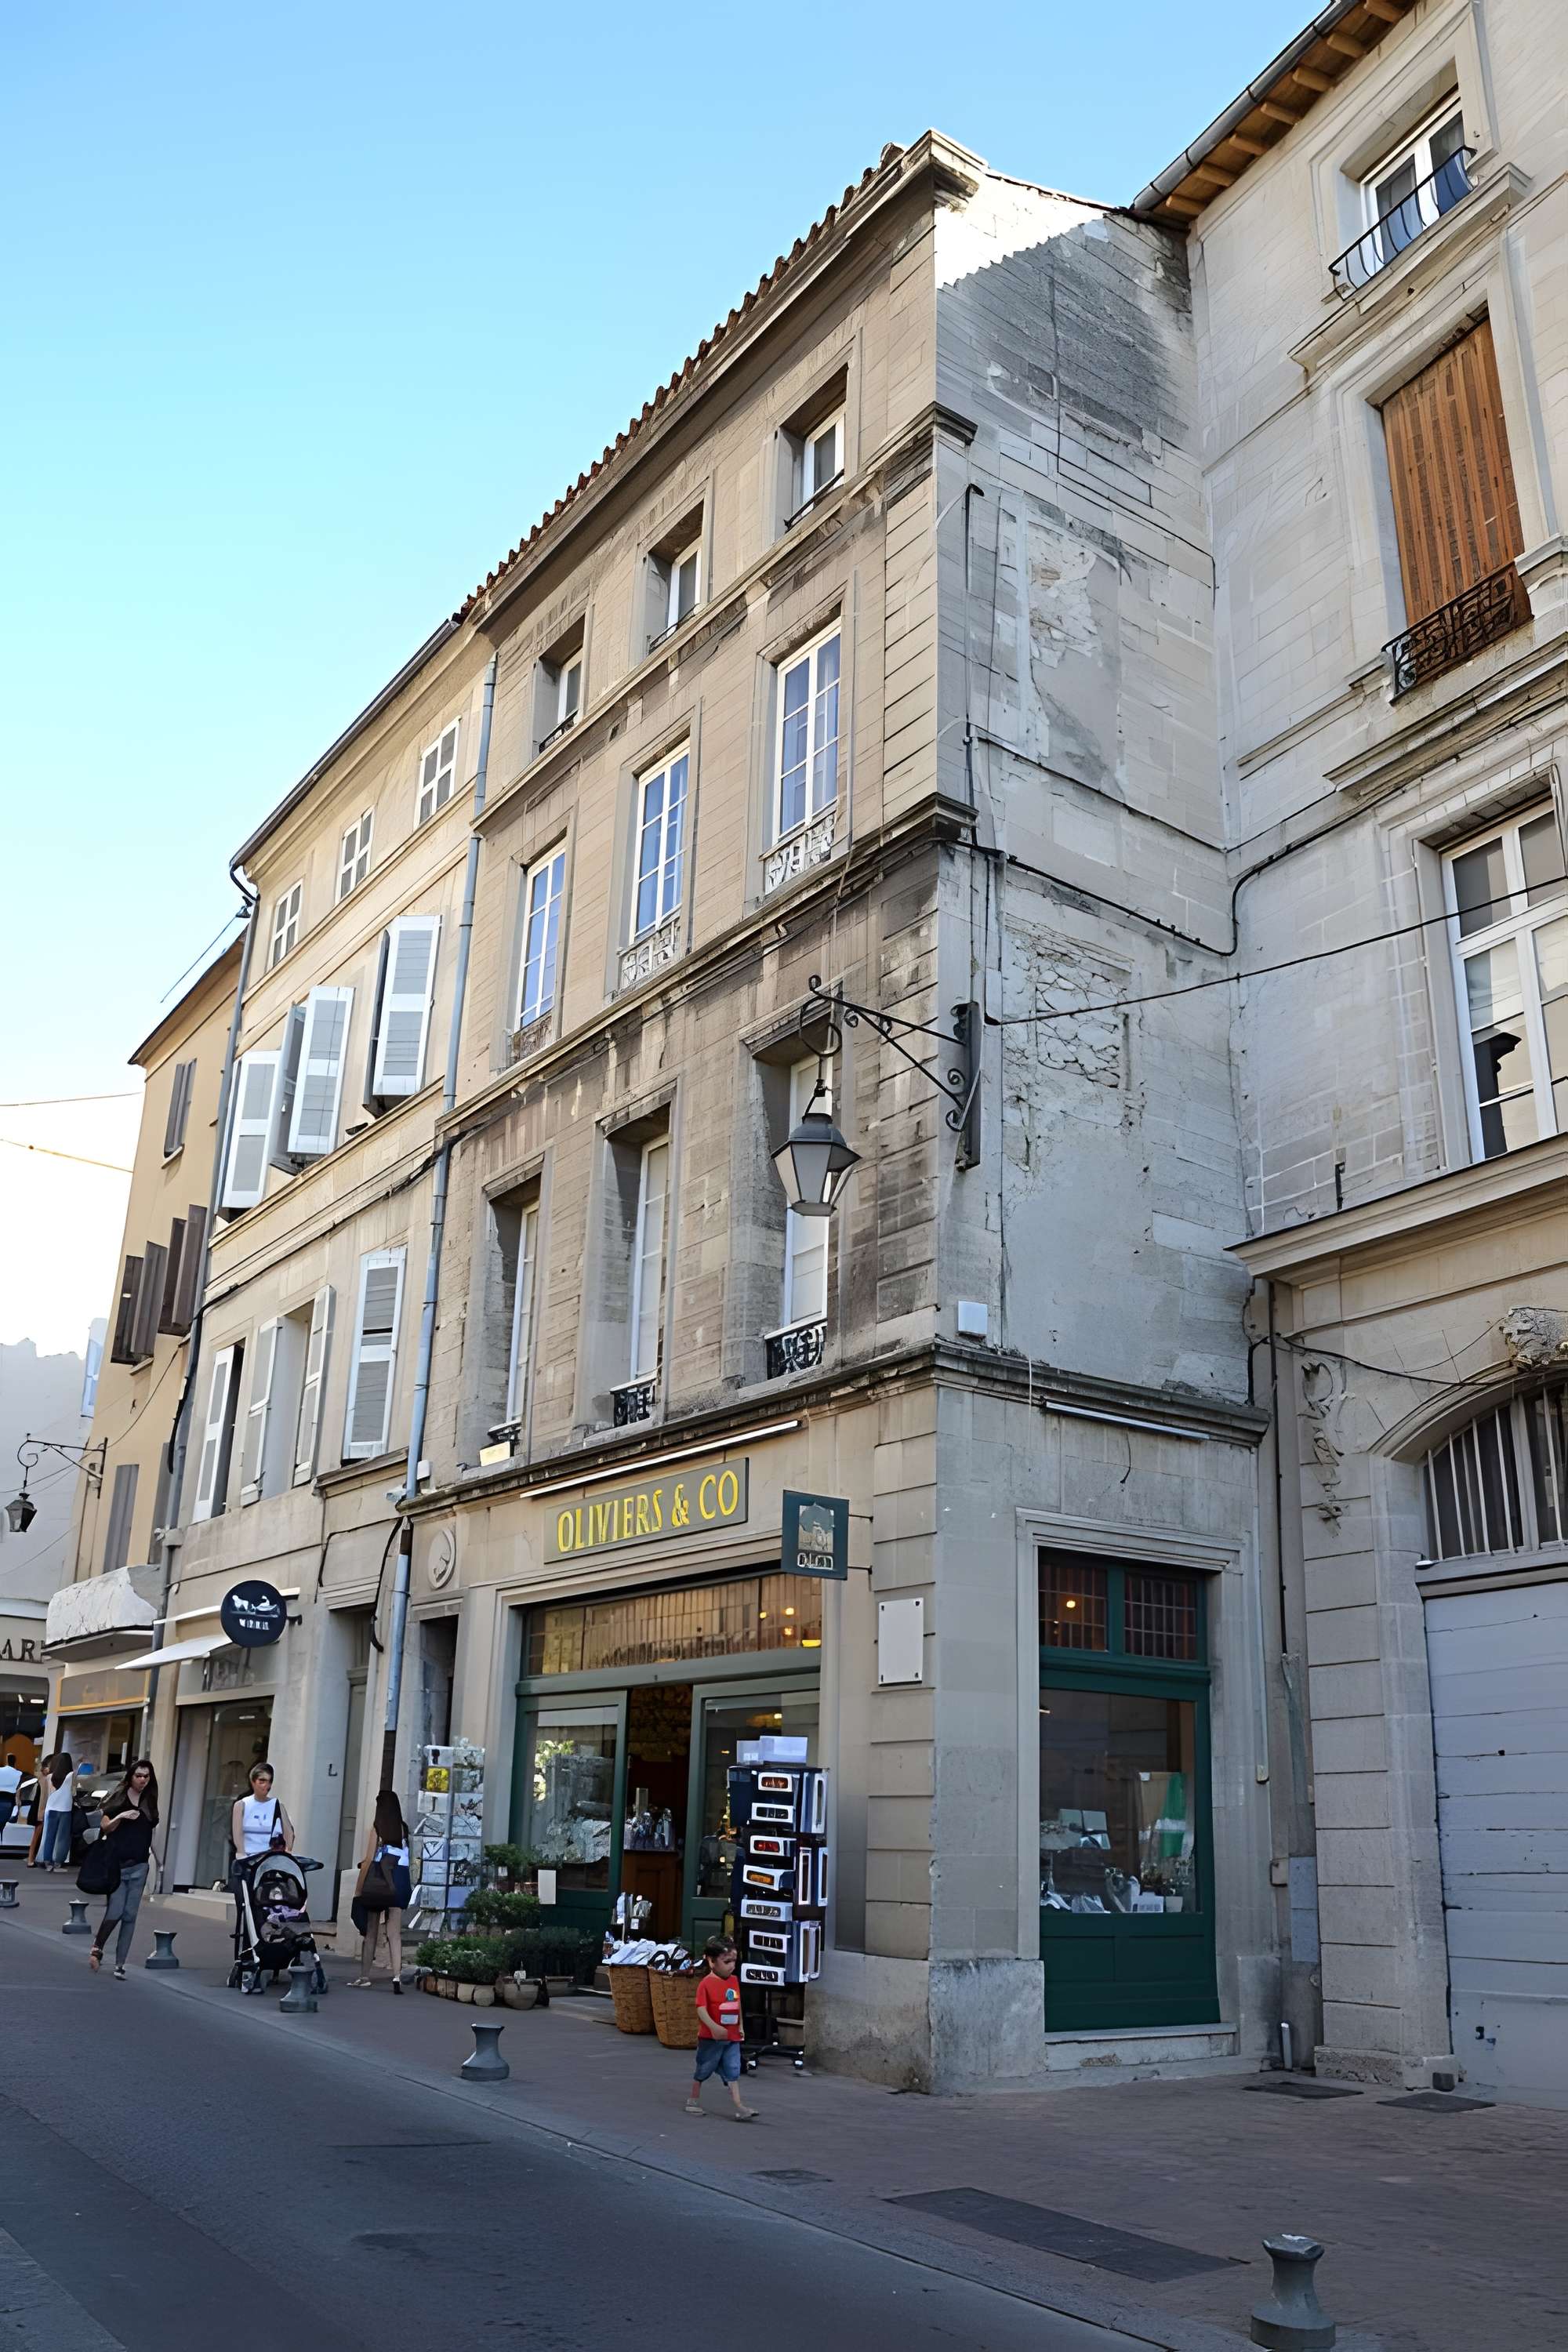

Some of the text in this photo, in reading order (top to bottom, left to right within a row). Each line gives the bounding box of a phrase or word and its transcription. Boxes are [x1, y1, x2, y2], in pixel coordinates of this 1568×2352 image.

[557, 1470, 739, 1552] OLIVIERS & CO
